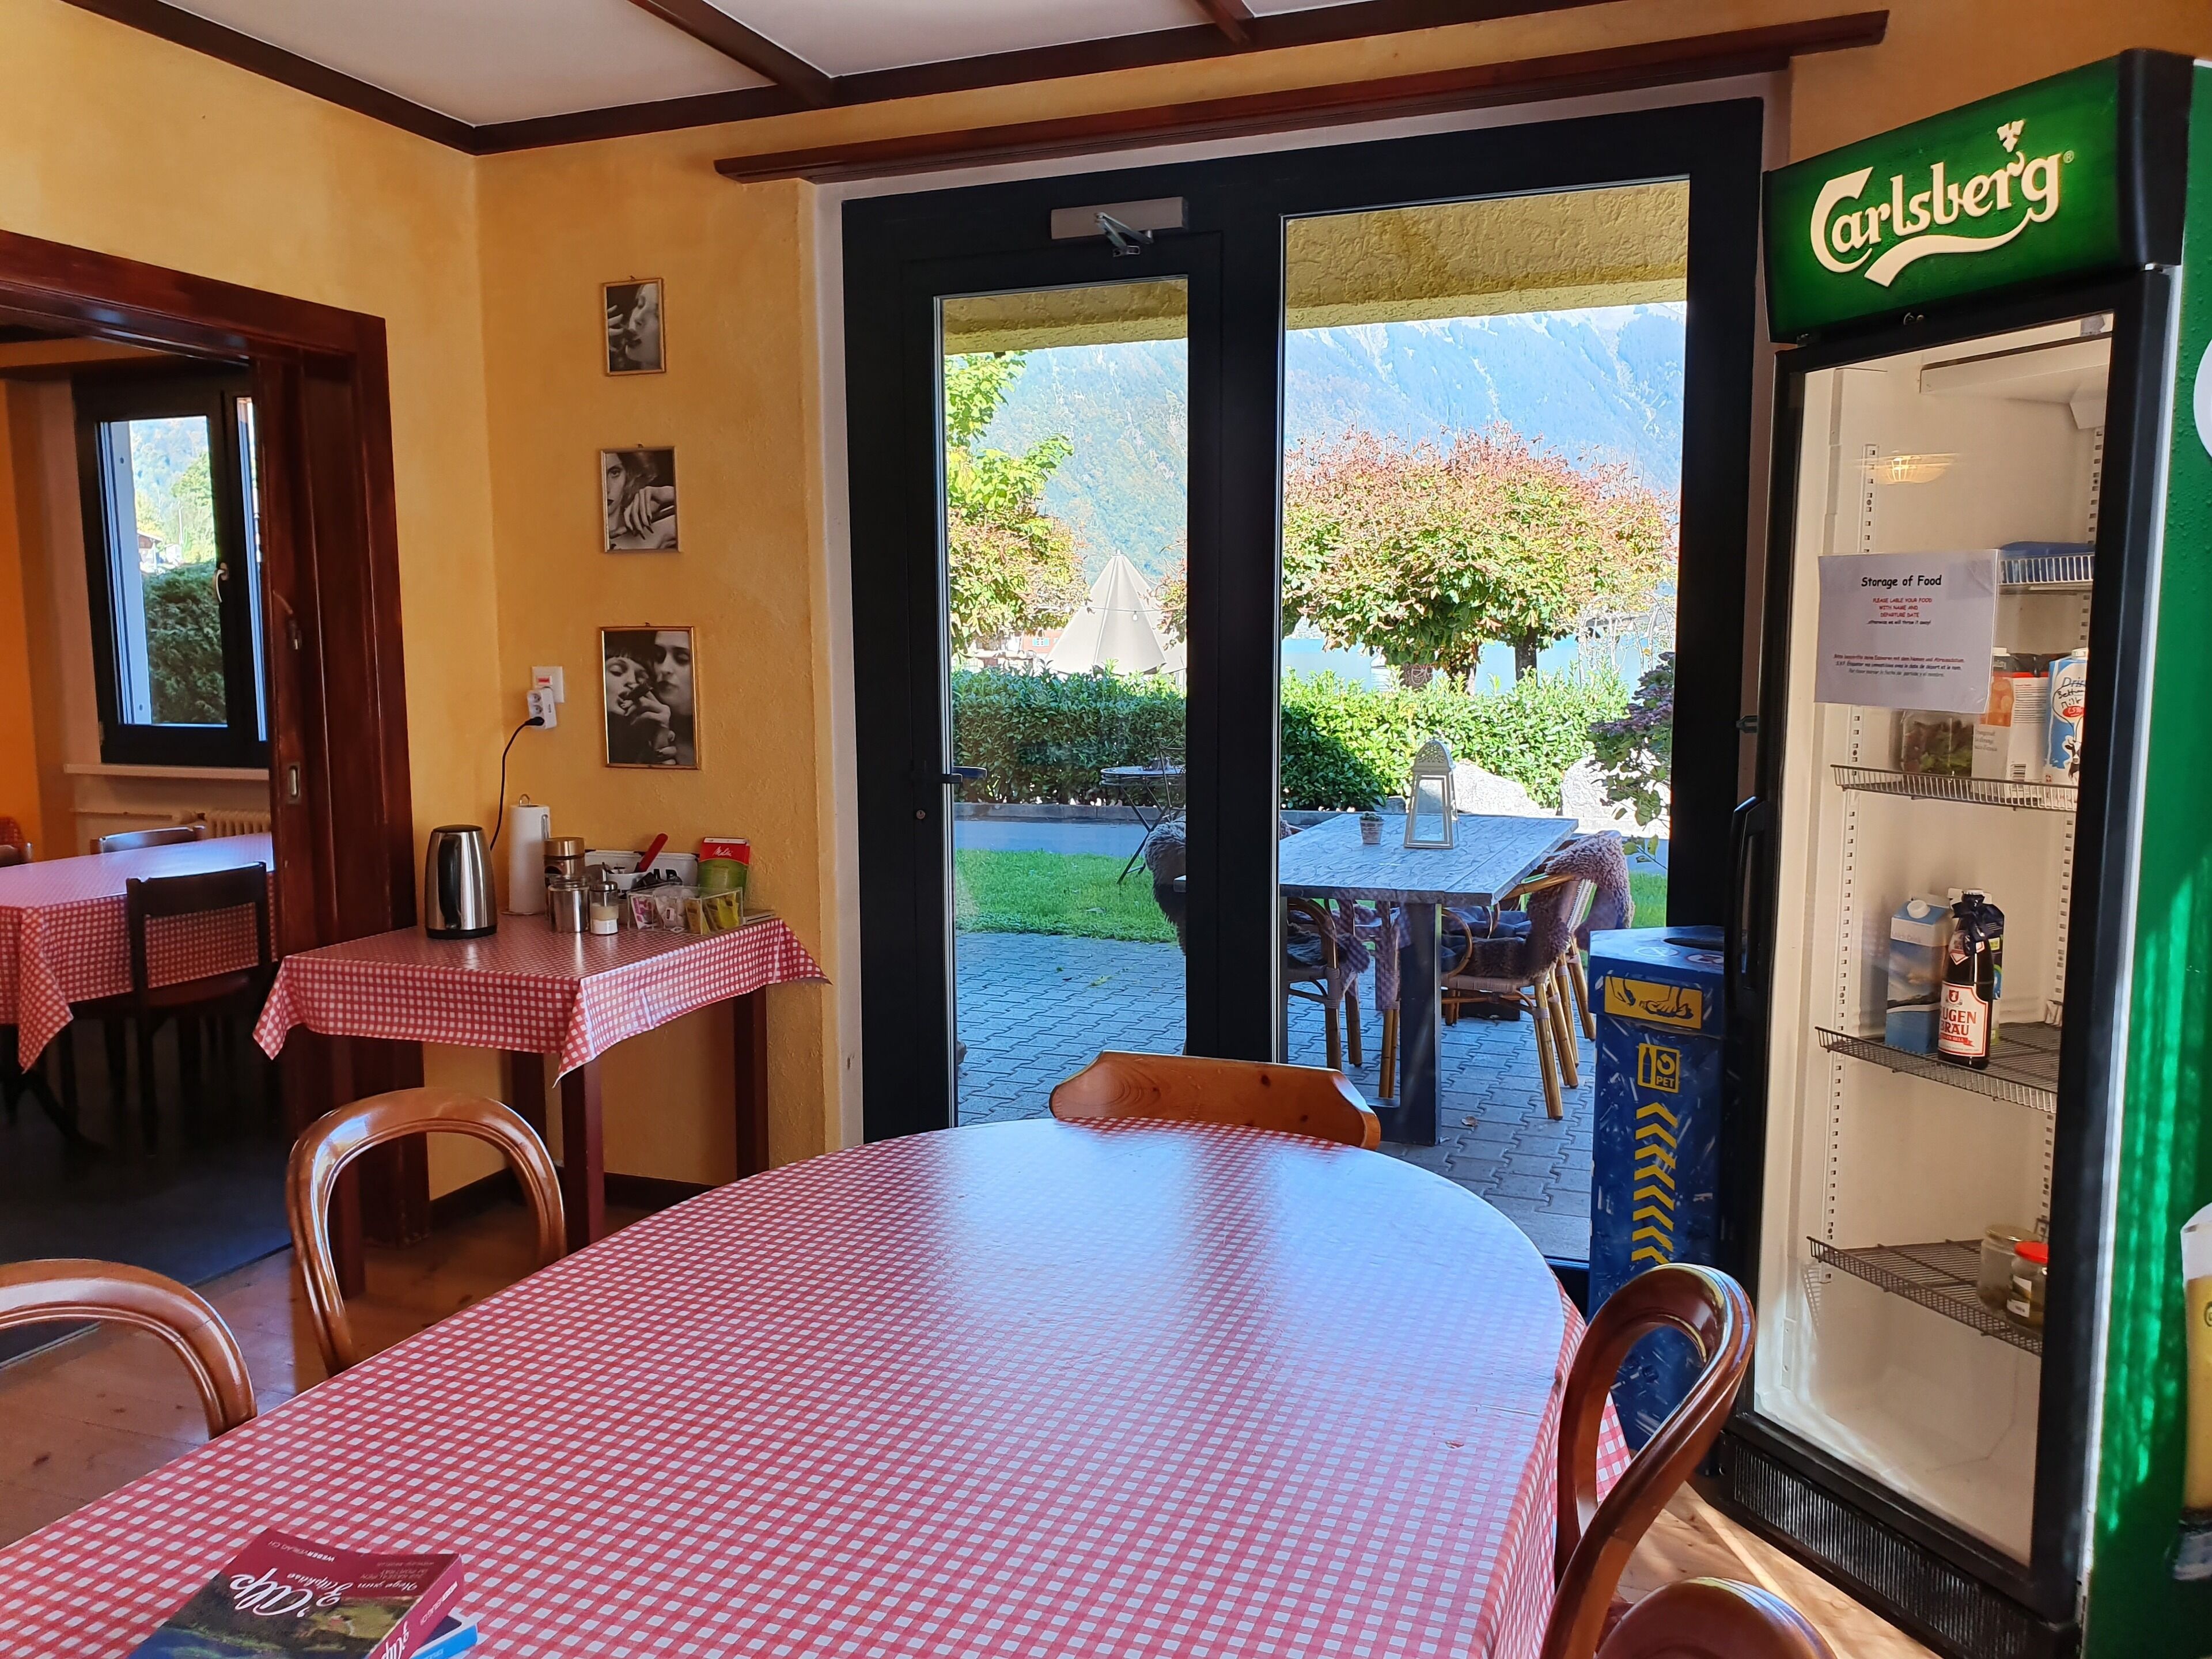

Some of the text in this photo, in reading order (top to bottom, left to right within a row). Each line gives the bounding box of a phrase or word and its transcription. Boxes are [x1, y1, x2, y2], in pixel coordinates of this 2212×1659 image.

[1810, 152, 2062, 287] Carlsberg
[1861, 574, 1942, 589] Storage of Food
[1940, 1006, 1977, 1024] UGEN
[1656, 1075, 1675, 1087] PET
